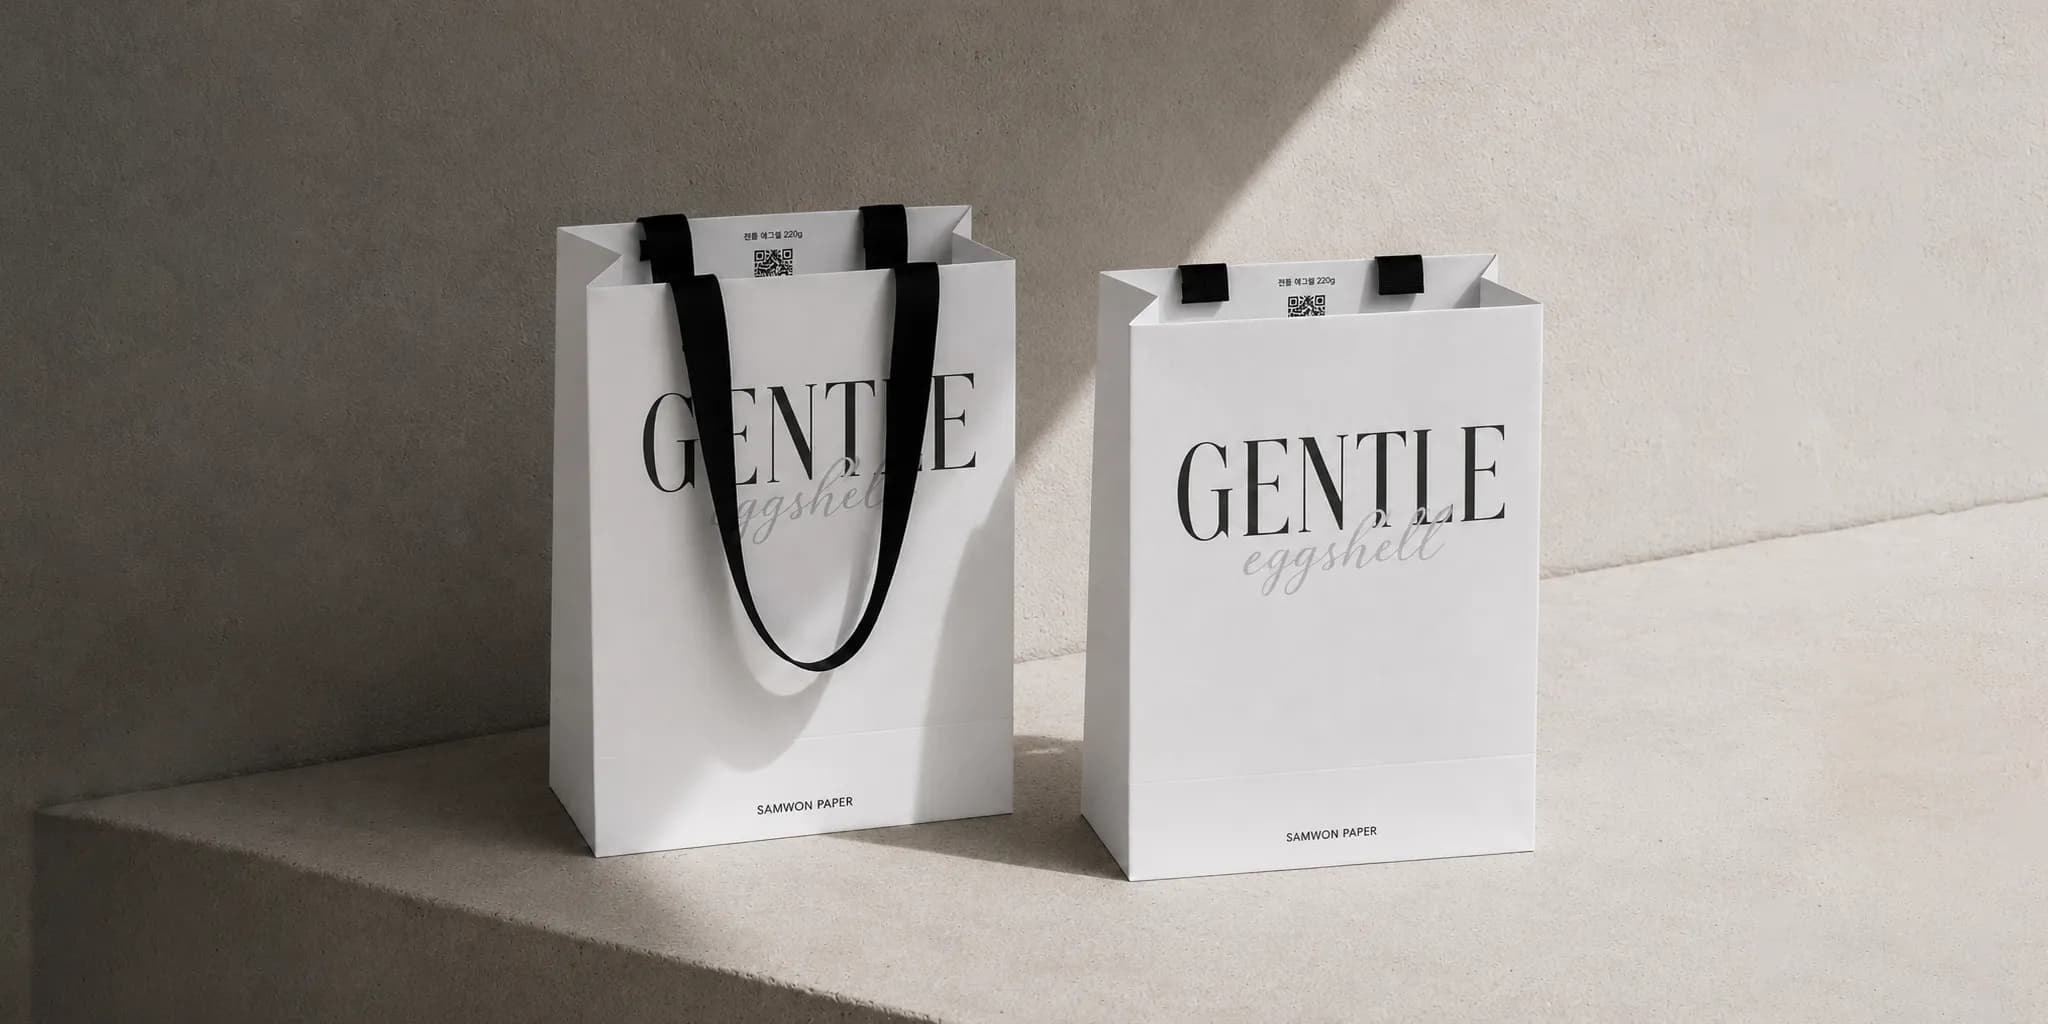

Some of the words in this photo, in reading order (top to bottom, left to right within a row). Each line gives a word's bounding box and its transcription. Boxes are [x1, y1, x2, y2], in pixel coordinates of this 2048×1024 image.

[783, 230, 803, 239] 220g
[1317, 276, 1336, 286] 220g
[643, 373, 976, 493] GENTE
[1177, 424, 1506, 541] GENTLE
[1243, 503, 1454, 597] eggshell
[757, 800, 813, 815] SAMWON
[817, 796, 853, 809] PAPER
[1286, 829, 1338, 843] SAMWON
[1342, 826, 1377, 838] PAPER
